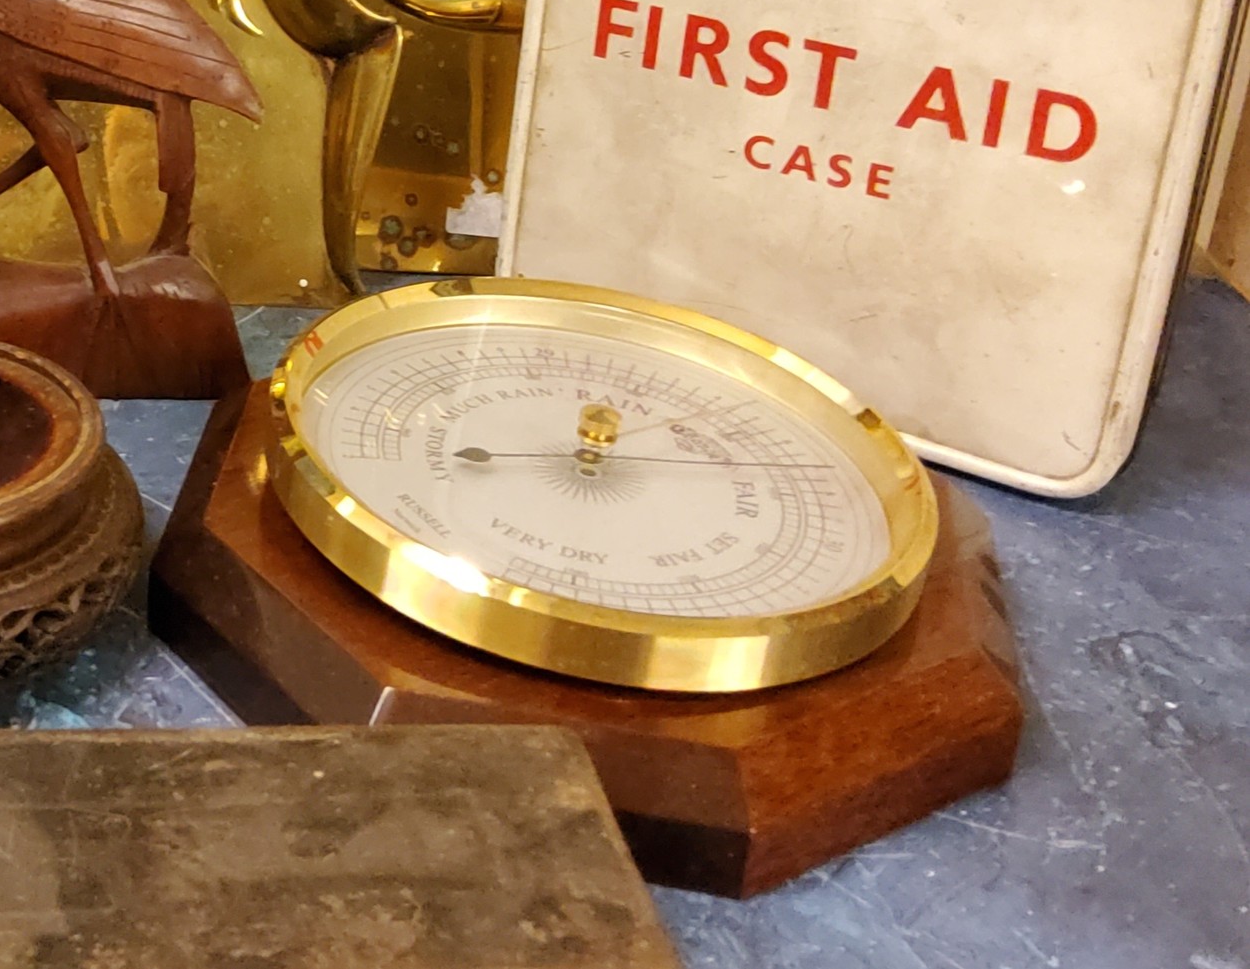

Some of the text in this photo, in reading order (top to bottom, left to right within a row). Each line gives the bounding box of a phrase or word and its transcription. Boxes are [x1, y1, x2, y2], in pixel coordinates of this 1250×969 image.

[896, 66, 1098, 163] AID
[744, 135, 894, 200] CASE
[440, 387, 553, 423] MUCH RAIN
[575, 388, 653, 416] RAIN
[425, 426, 455, 483] STORMY
[731, 481, 759, 518] FAIR
[491, 517, 609, 564] VERY DRY
[647, 532, 740, 566] SET FAIR
